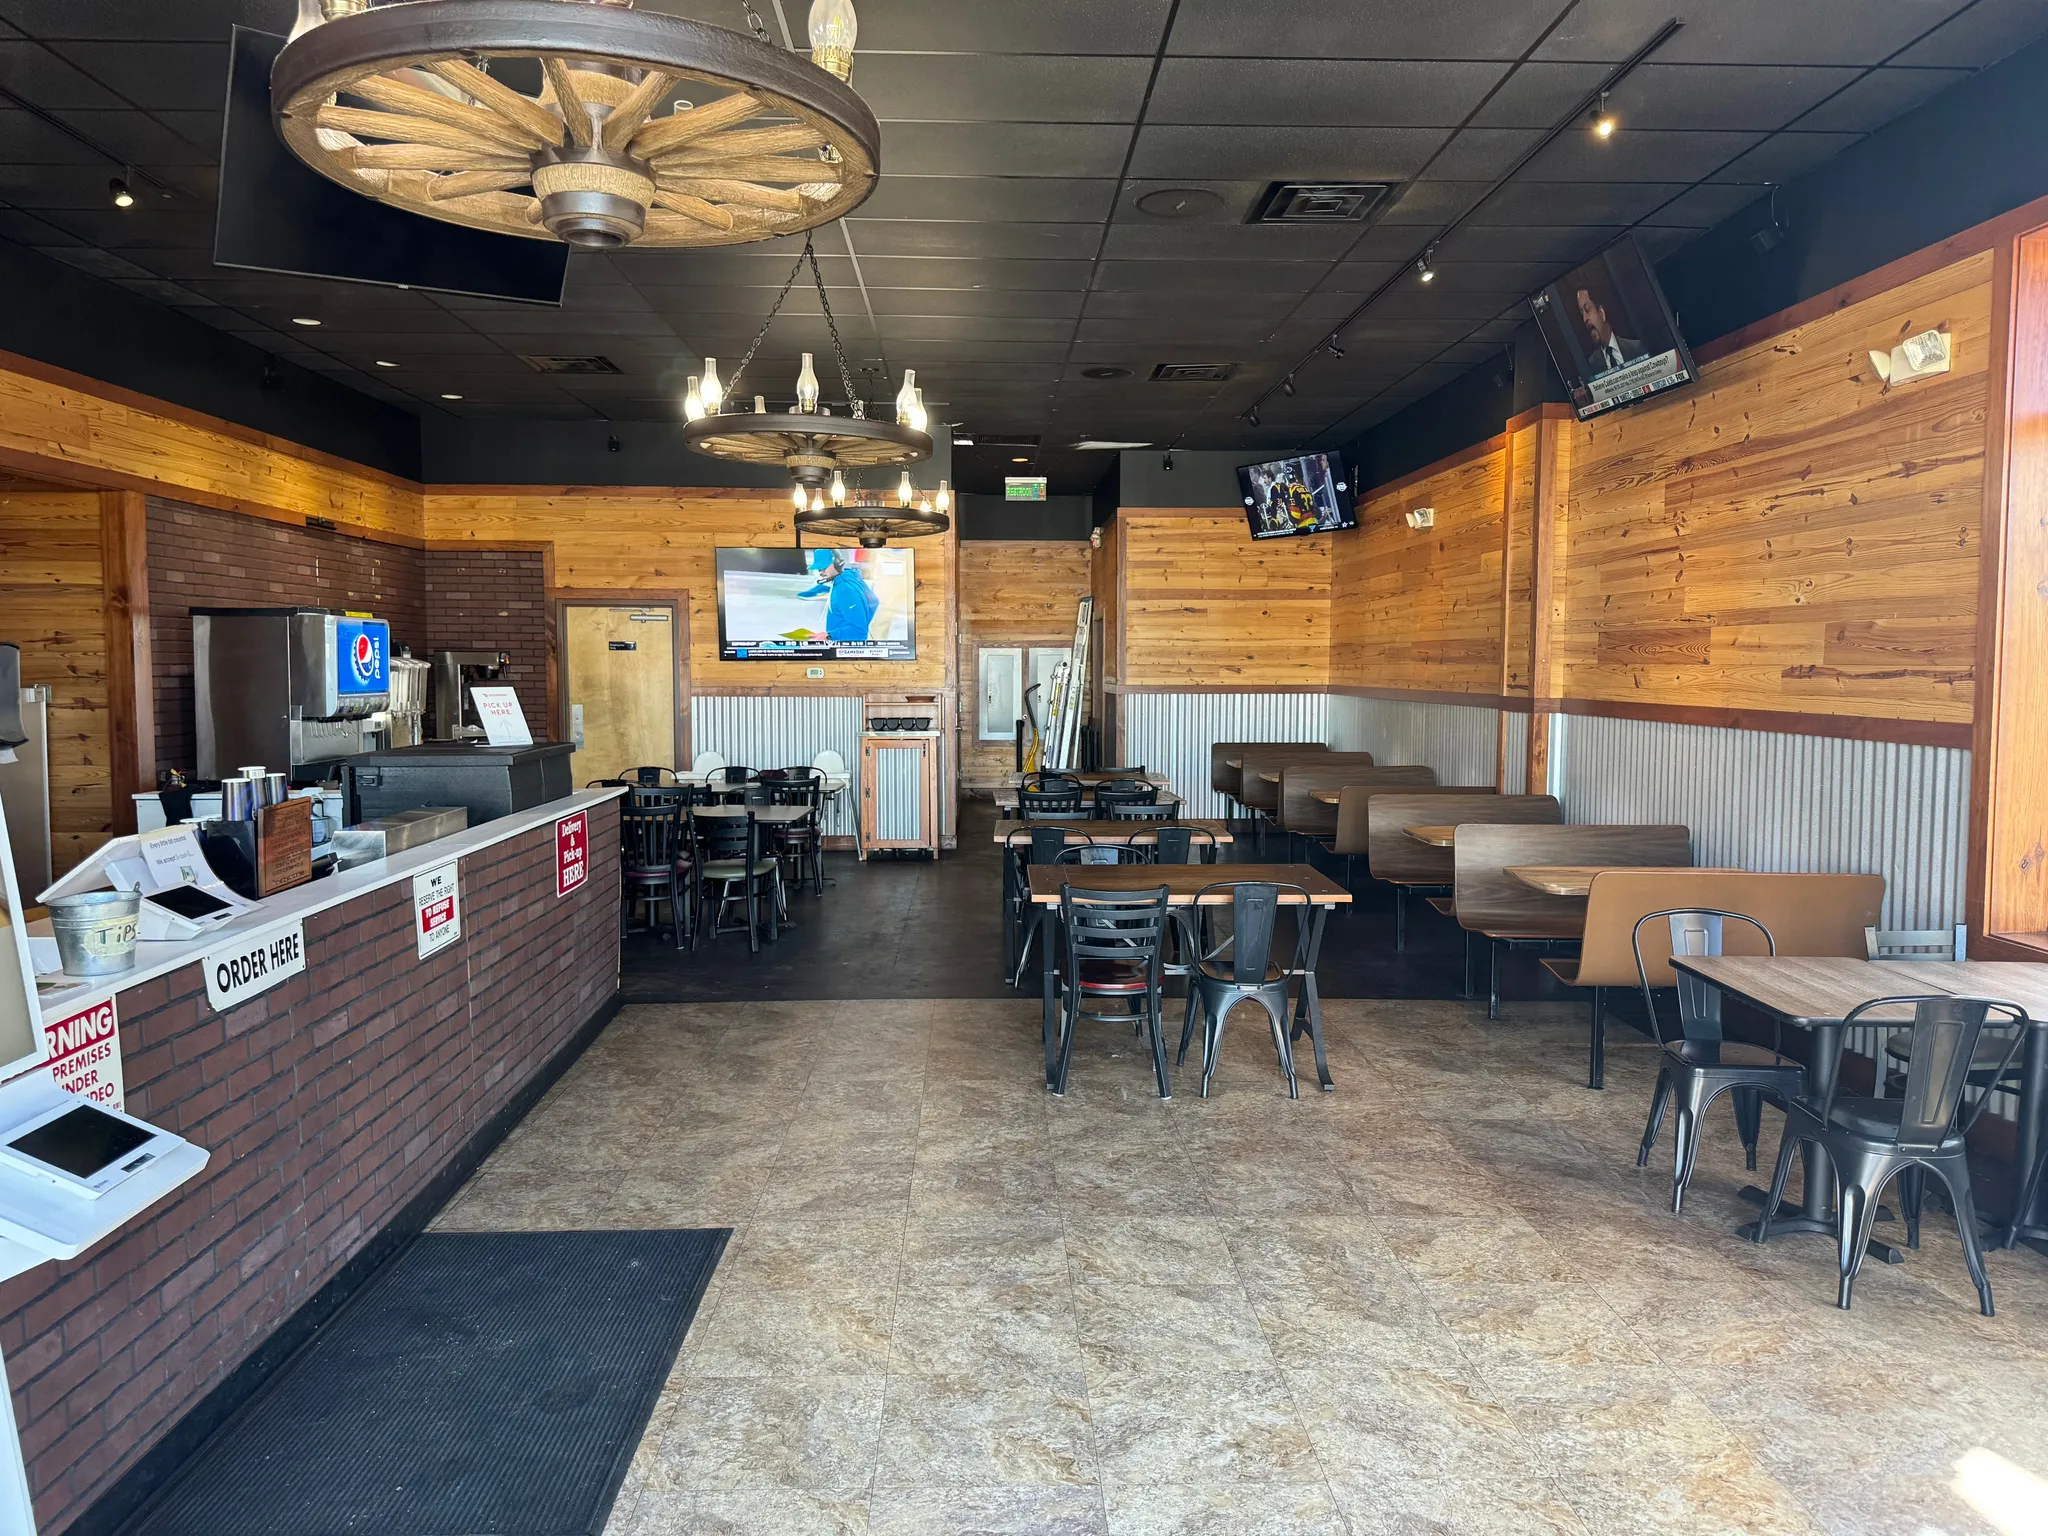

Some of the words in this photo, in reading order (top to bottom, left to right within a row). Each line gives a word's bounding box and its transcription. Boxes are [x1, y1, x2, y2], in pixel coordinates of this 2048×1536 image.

[1649, 355, 1669, 371] Cowboys?
[1675, 372, 1685, 381] FOX
[373, 636, 381, 680] pepsi
[561, 820, 582, 837] Delivery
[563, 847, 583, 865] Pick-up
[430, 875, 442, 888] WE
[562, 860, 584, 888] HERE
[418, 891, 436, 906] RESERVE
[435, 887, 443, 898] THE
[443, 882, 455, 895] RIGHT
[425, 907, 433, 919] TO
[432, 899, 450, 915] REFUSE
[429, 911, 447, 928] SERVICE
[429, 933, 435, 942] TO
[435, 924, 450, 939] ANYONE
[216, 948, 268, 993] ORDER
[269, 932, 299, 971] HERE
[45, 1006, 113, 1059] RNING
[52, 1042, 111, 1081] PREMISES
[61, 1069, 99, 1094] NDER
[86, 1082, 115, 1102] DEO
